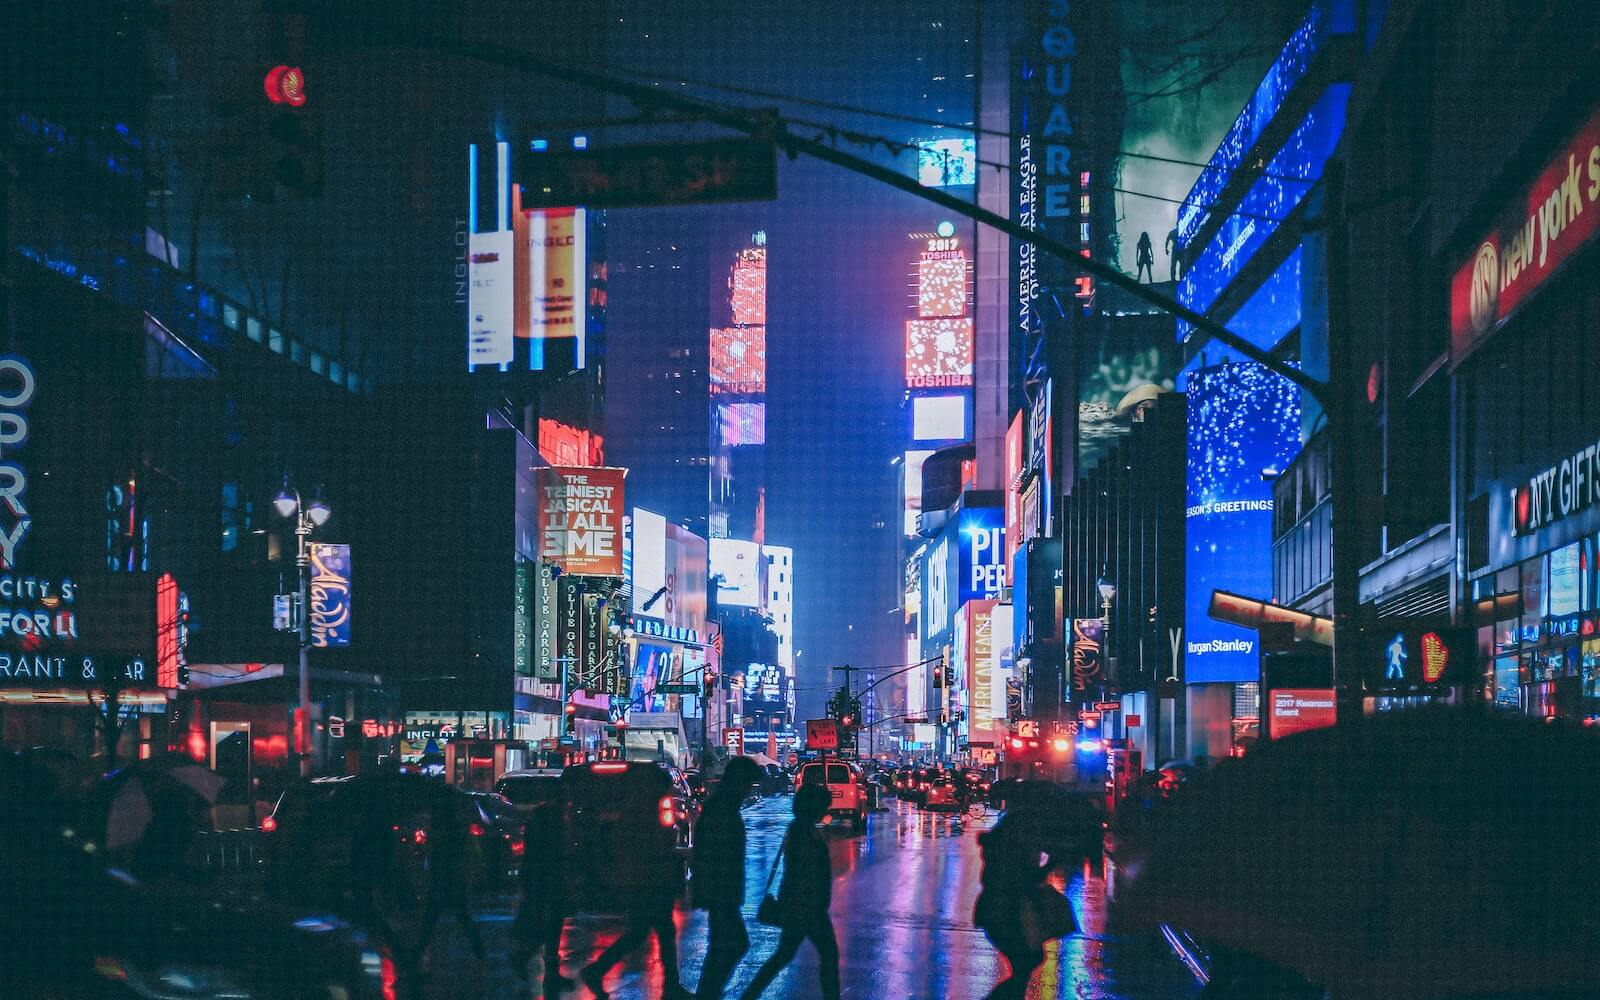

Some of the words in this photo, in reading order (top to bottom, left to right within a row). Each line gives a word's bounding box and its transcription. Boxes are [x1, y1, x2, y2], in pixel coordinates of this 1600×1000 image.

[1019, 134, 1031, 206] EAGLE
[1501, 214, 1536, 293] new
[1539, 153, 1583, 268] york
[927, 239, 959, 252] 2017
[455, 217, 467, 303] INGLOT
[920, 251, 965, 261] TOSHIBA
[1019, 212, 1031, 332] AMERICN
[906, 375, 973, 388] TOSHIBA
[564, 474, 588, 485] THE
[1213, 499, 1274, 513] GREETINGS
[1510, 487, 1518, 538] I
[1529, 467, 1557, 529] NY
[572, 513, 614, 531] ALL
[0, 580, 50, 597] CITY
[311, 548, 350, 648] Aladdin
[541, 568, 550, 615] OLIVE
[567, 584, 577, 628] OLIVE
[0, 612, 50, 637] FOR
[588, 598, 598, 638] OLIVE
[1211, 639, 1253, 655] Stanley
[82, 659, 96, 679] &
[975, 657, 992, 732] AMERICAN
[1275, 699, 1295, 708] 2017
[1275, 708, 1299, 717] Event
[407, 730, 457, 740] INGLOT
